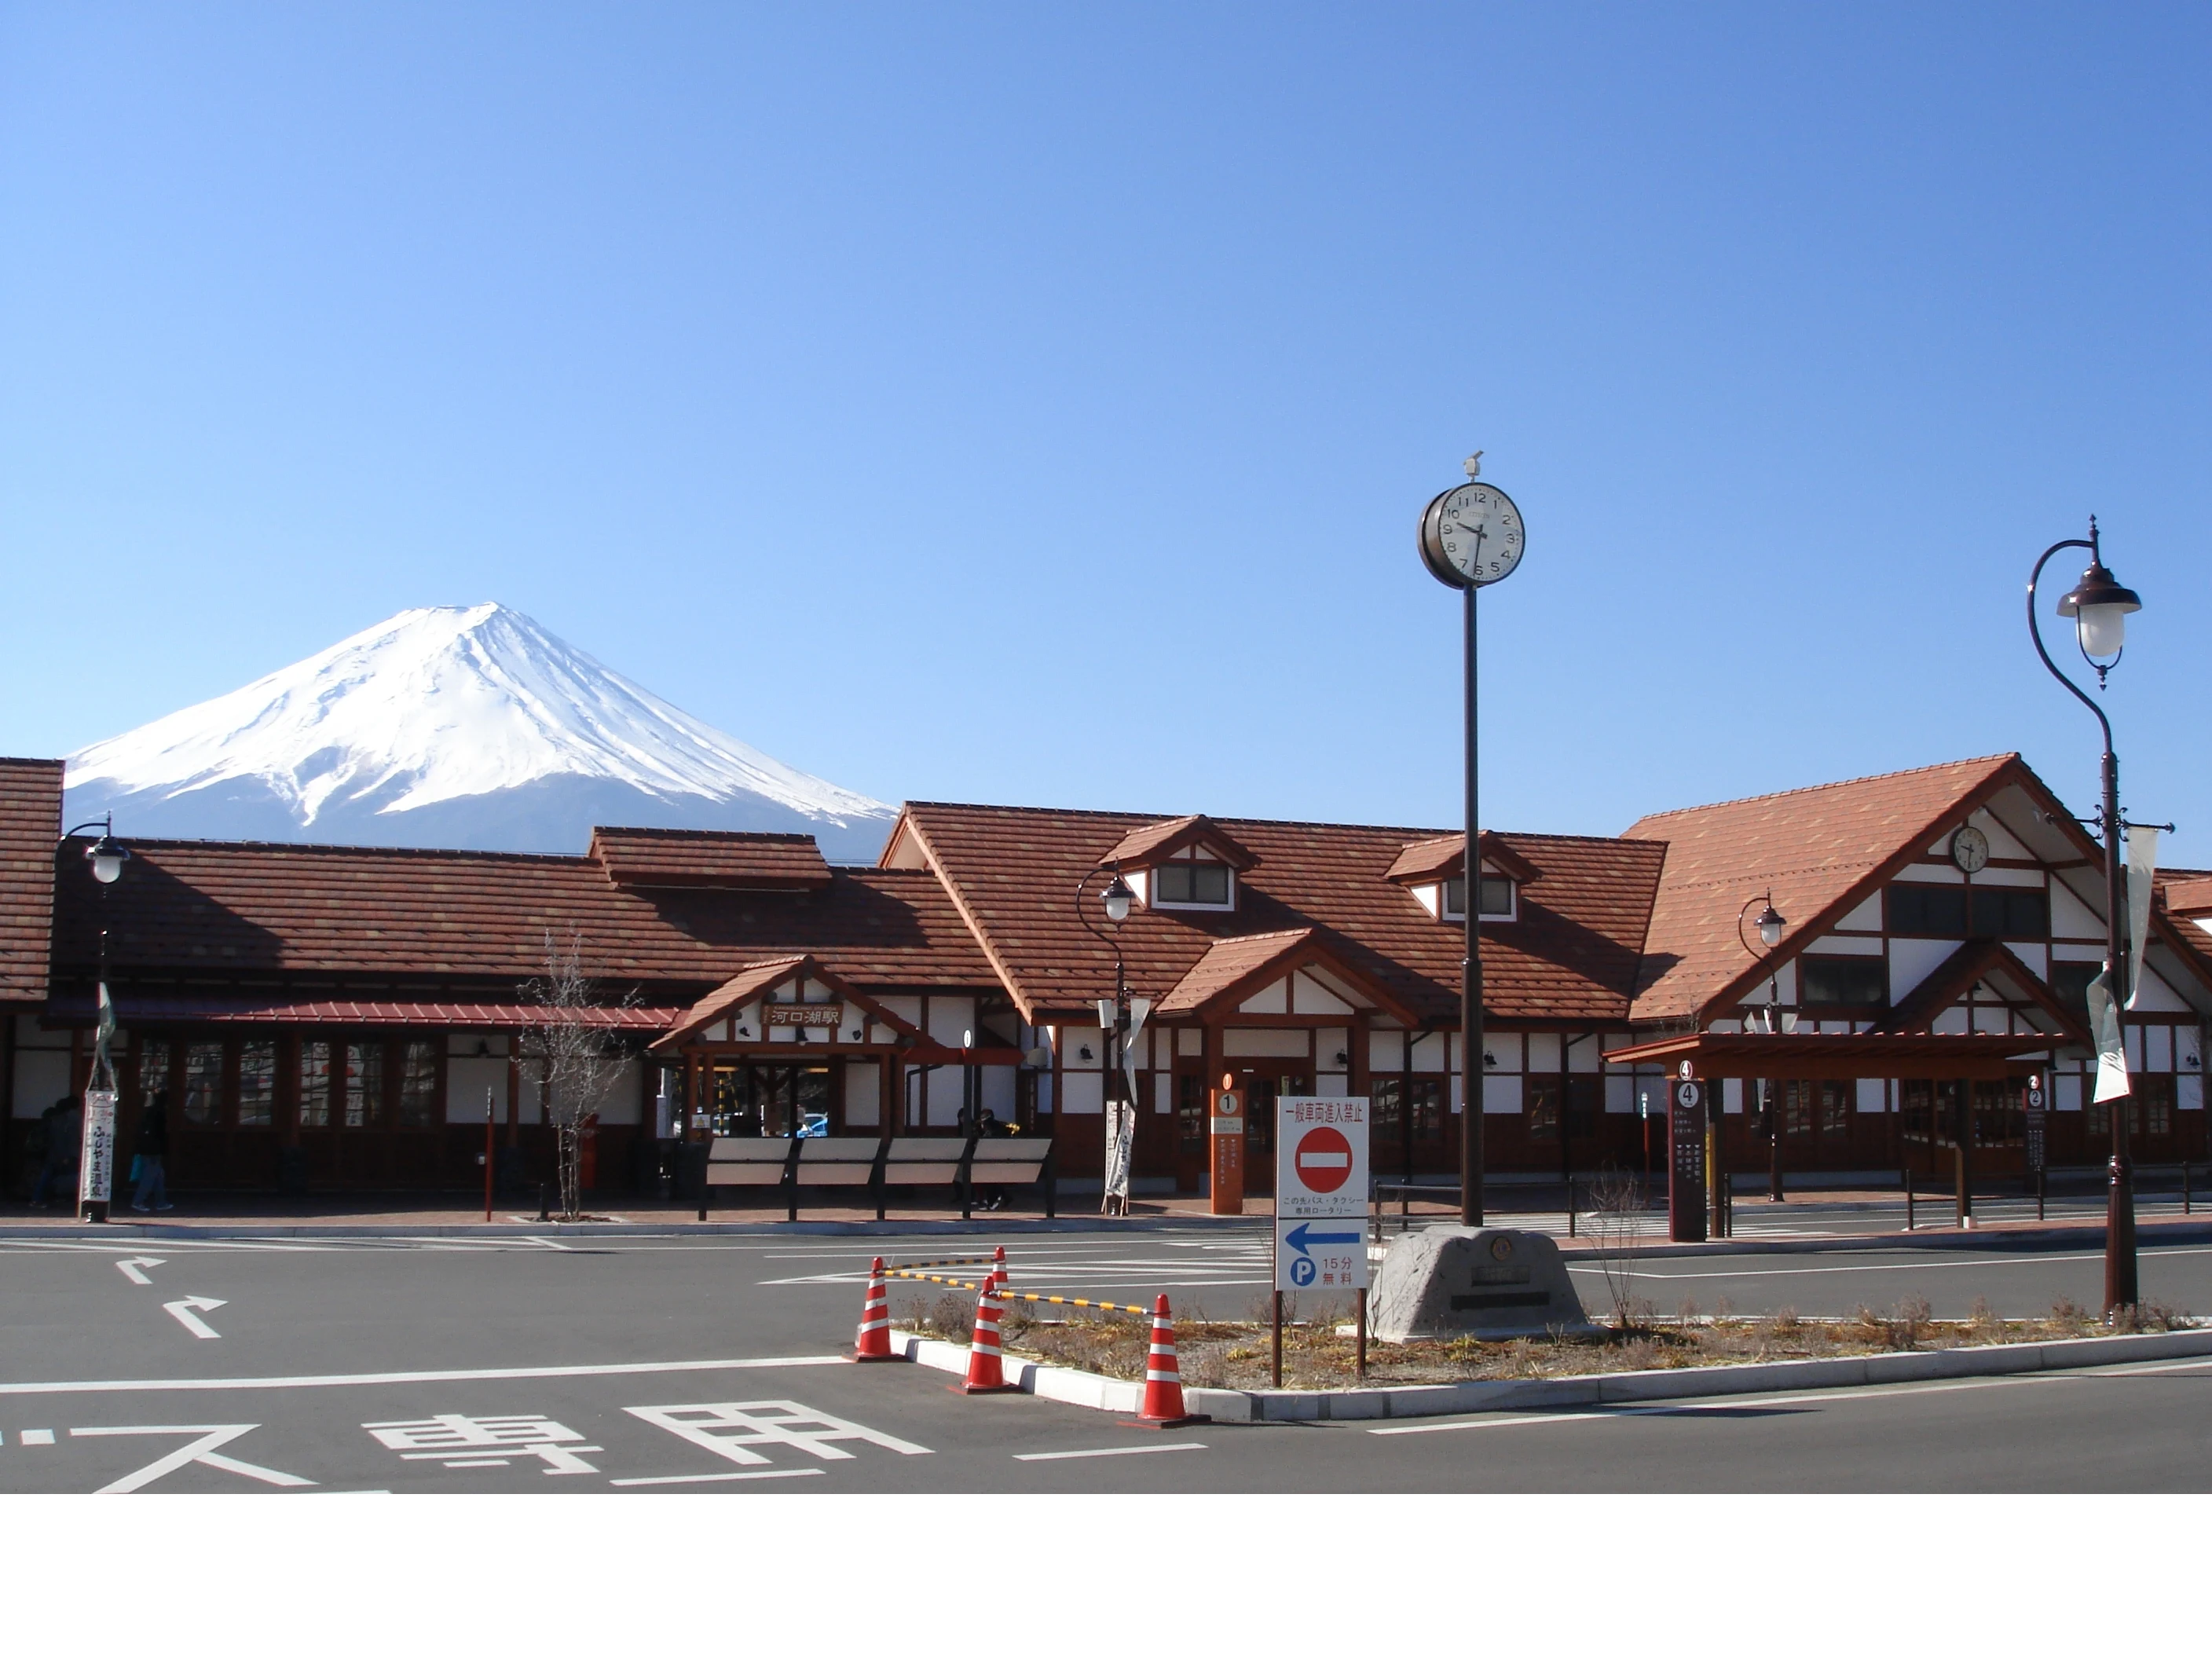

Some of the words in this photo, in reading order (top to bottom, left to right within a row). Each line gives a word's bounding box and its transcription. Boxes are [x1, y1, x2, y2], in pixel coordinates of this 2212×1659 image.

[1458, 496, 1470, 507] 11
[1474, 493, 1486, 504] 12
[1492, 500, 1497, 509] 1
[1447, 508, 1460, 519] 10
[1502, 515, 1511, 525] 2
[1442, 524, 1453, 535] 9
[1506, 533, 1515, 544] 3
[1446, 542, 1457, 553] 8
[1500, 549, 1511, 560] 4
[1459, 558, 1468, 569] 7
[1490, 562, 1500, 573] 5
[1474, 565, 1484, 576] 6
[771, 1010, 839, 1024] 河口湖駅
[1683, 1084, 1693, 1101] 4
[2032, 1090, 2038, 1103] 2
[1223, 1094, 1230, 1109] 1
[1285, 1101, 1364, 1123] 一般車両進入禁止
[1283, 1196, 1364, 1206] この先バス・タクシー
[1295, 1206, 1352, 1215] 専用ロータリー
[1323, 1256, 1353, 1269] 15分
[1323, 1272, 1353, 1286] 無料
